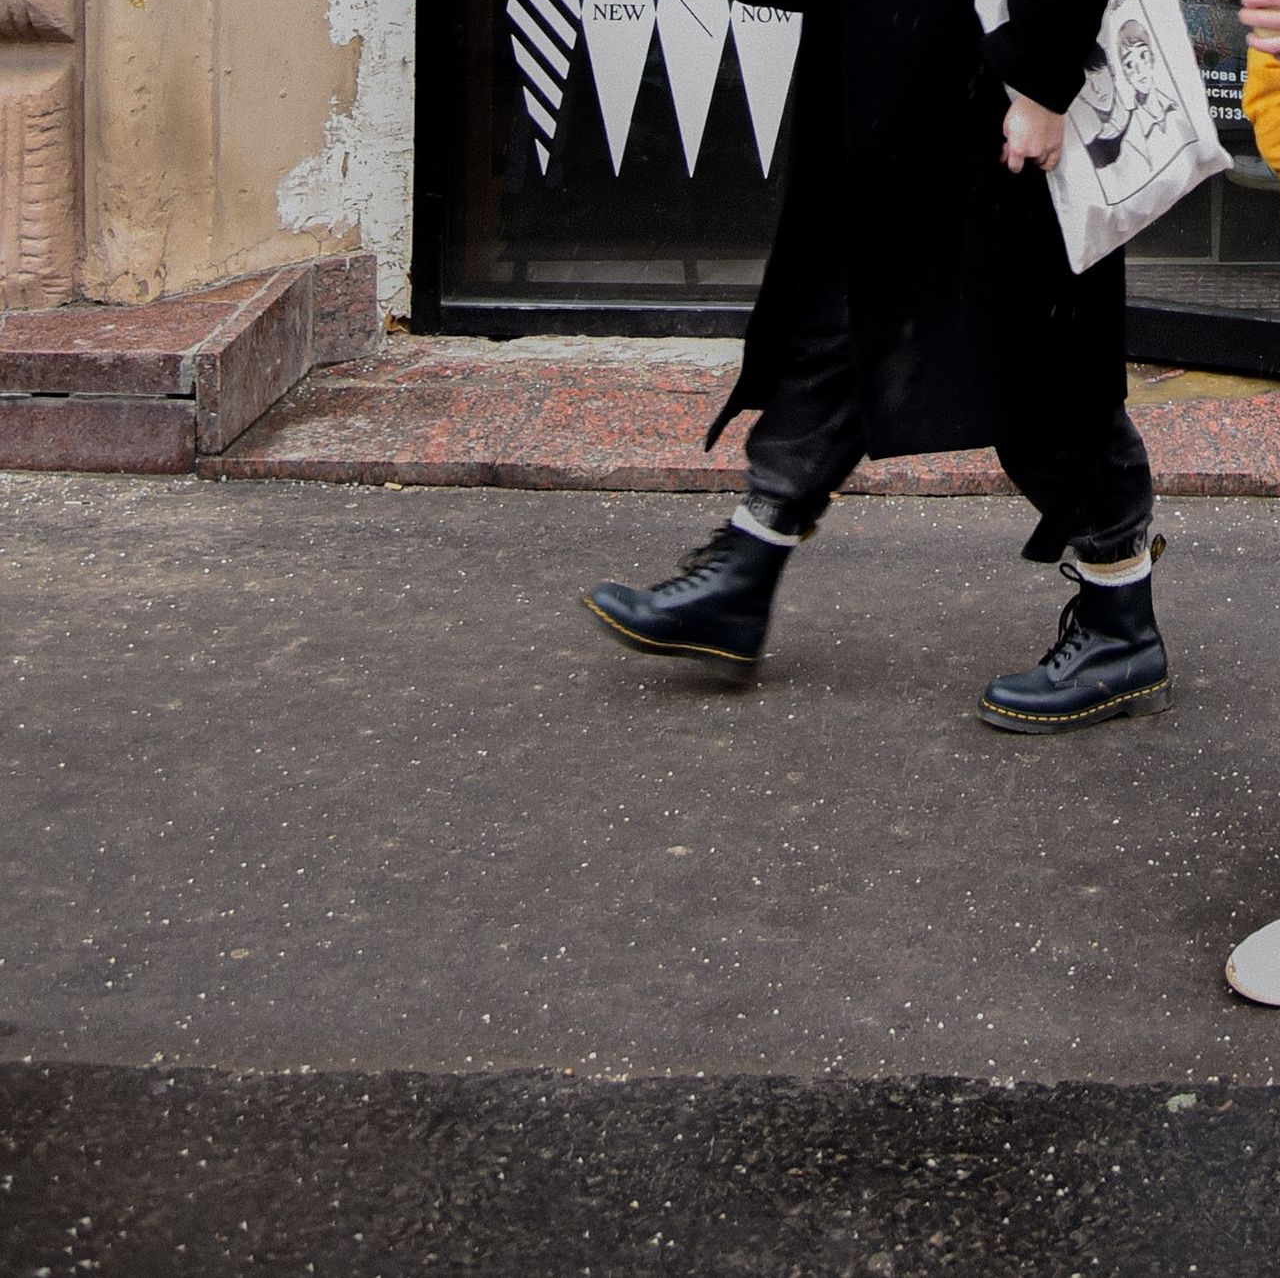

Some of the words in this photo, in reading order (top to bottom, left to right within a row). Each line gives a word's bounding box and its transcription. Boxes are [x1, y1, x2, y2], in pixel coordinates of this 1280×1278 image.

[593, 4, 646, 21] NEW
[741, 6, 793, 23] NOW
[1201, 69, 1237, 82] нова
[1210, 105, 1251, 121] 6133
